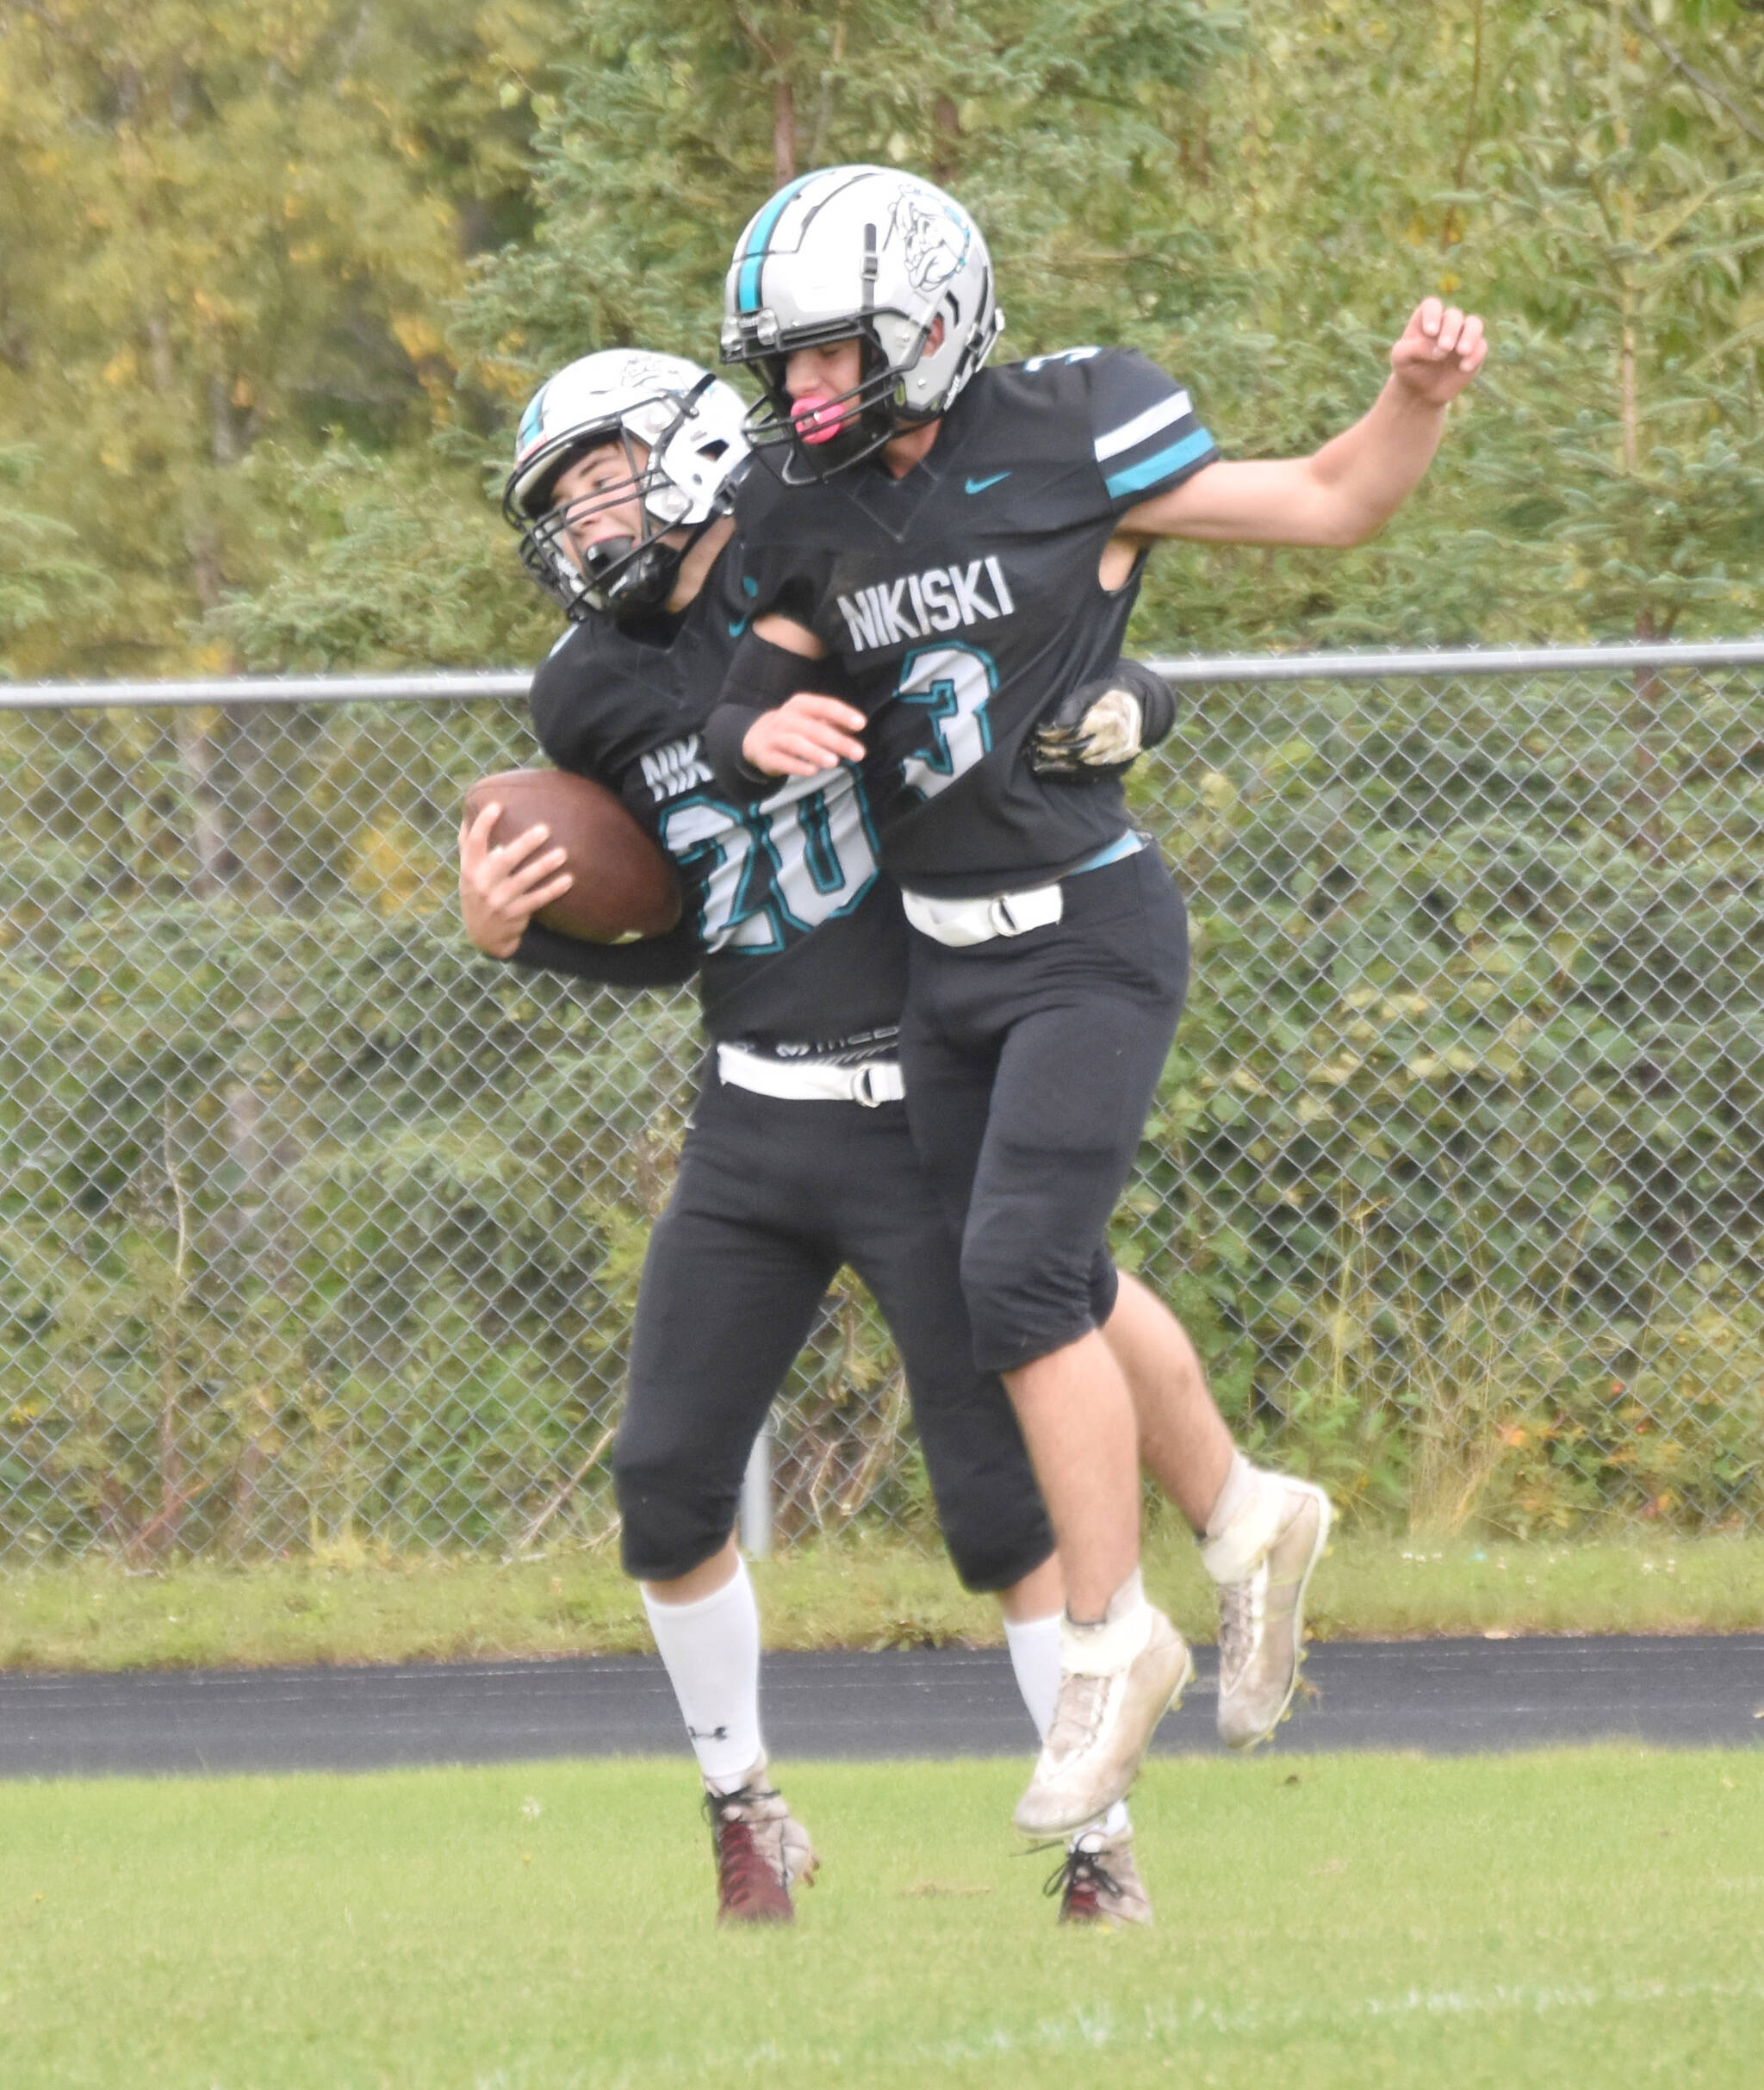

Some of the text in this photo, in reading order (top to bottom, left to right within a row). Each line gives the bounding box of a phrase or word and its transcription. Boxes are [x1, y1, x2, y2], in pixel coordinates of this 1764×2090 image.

[836, 555, 1015, 652] NIKISKI
[640, 733, 714, 803] NIK
[892, 639, 1000, 802] 3
[659, 758, 879, 955] 20
